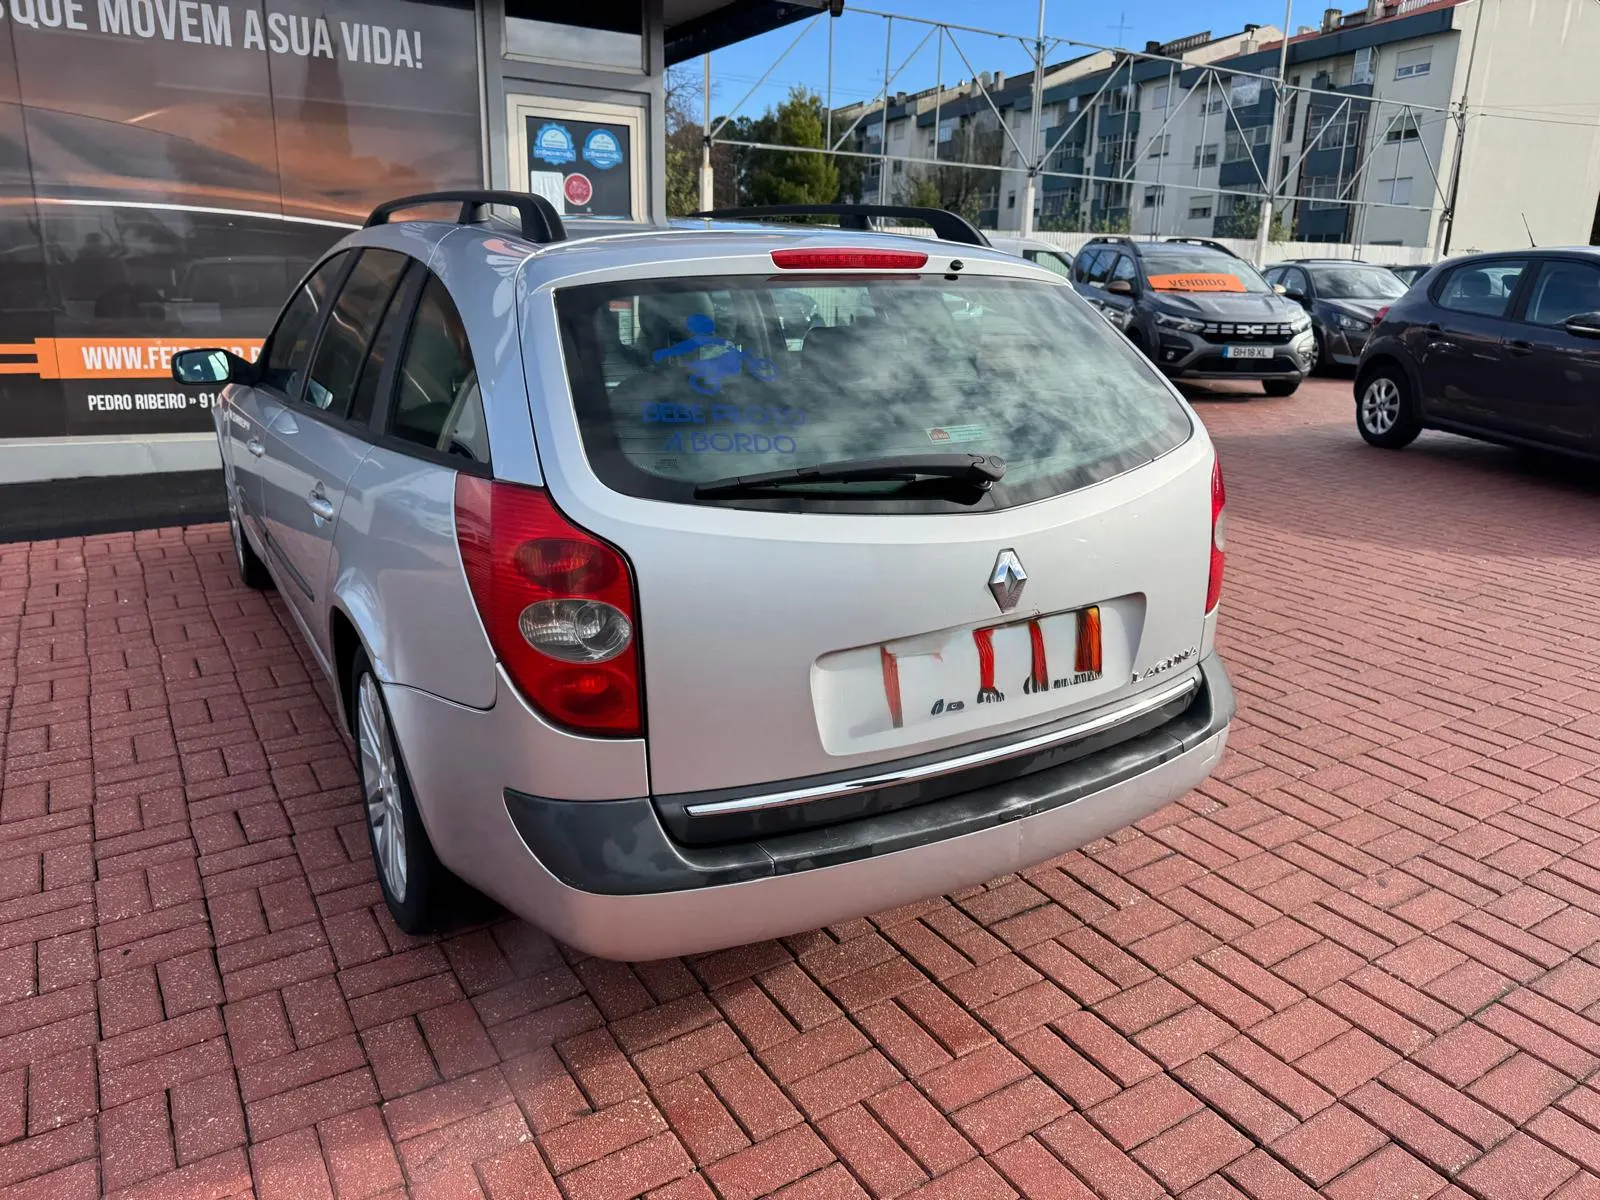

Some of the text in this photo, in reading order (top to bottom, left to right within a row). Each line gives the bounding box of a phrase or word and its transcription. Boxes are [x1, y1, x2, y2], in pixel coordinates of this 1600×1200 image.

[98, 0, 233, 47] MOVEM
[340, 21, 423, 70] VIDA!
[1168, 279, 1227, 288] VENDIDO
[87, 393, 132, 411] PEDRO
[135, 392, 187, 410] RIBEIRO
[690, 431, 797, 454] BORDO
[1131, 646, 1197, 684] LAGUNA
